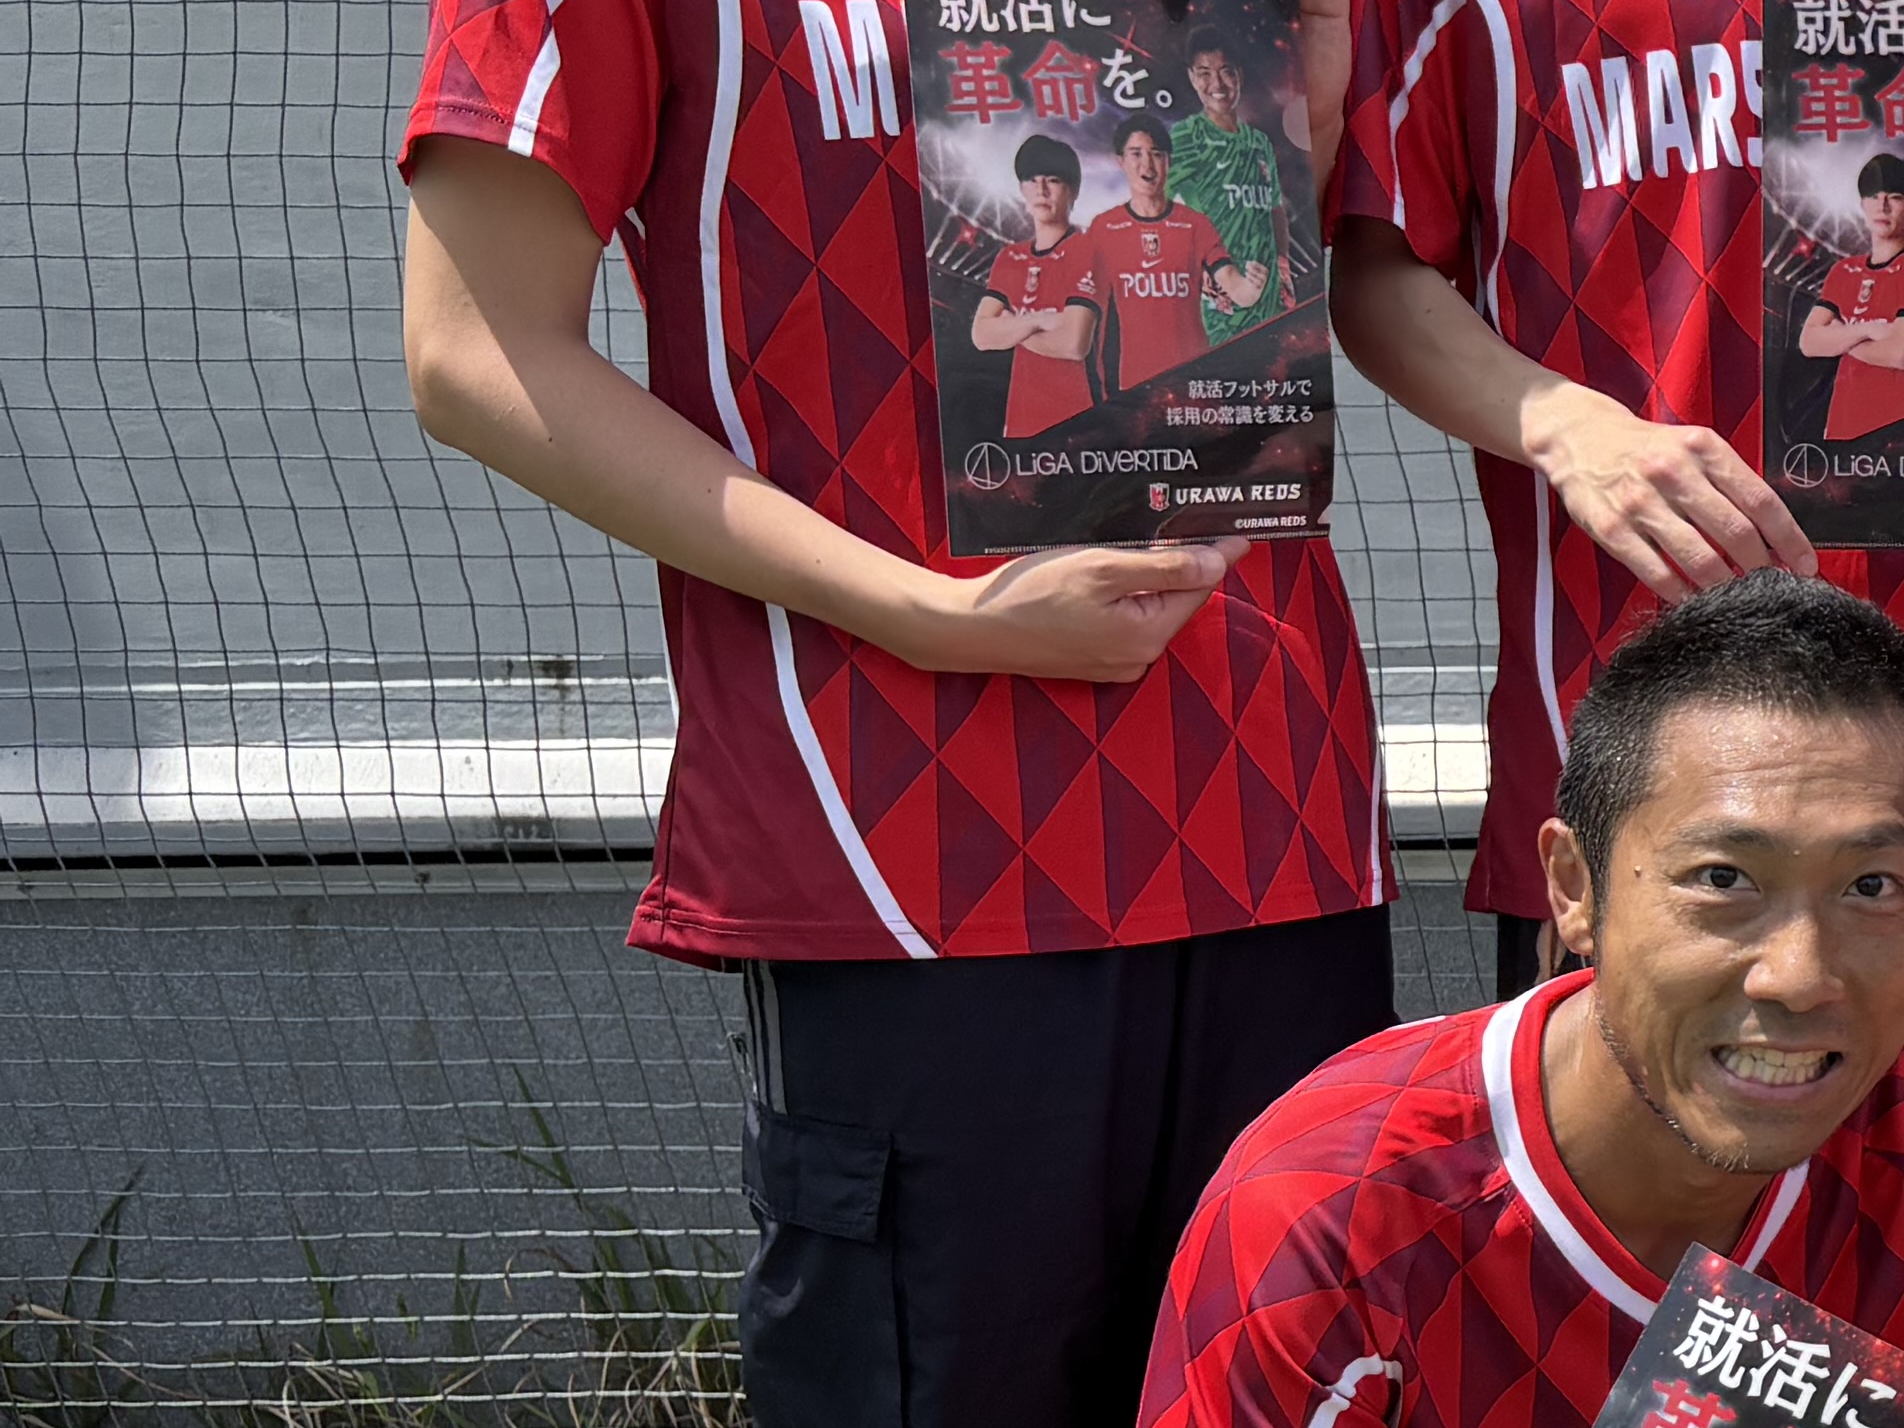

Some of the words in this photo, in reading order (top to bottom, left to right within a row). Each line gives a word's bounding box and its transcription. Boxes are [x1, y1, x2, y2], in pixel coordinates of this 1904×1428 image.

[939, 40, 1173, 125] 革命を。
[1120, 272, 1190, 299] POLUS
[1188, 378, 1313, 400] 就活フットサルで
[1167, 404, 1314, 426] 採用の常識を変える
[1175, 484, 1244, 505] URAWA
[1251, 482, 1301, 502] REDS
